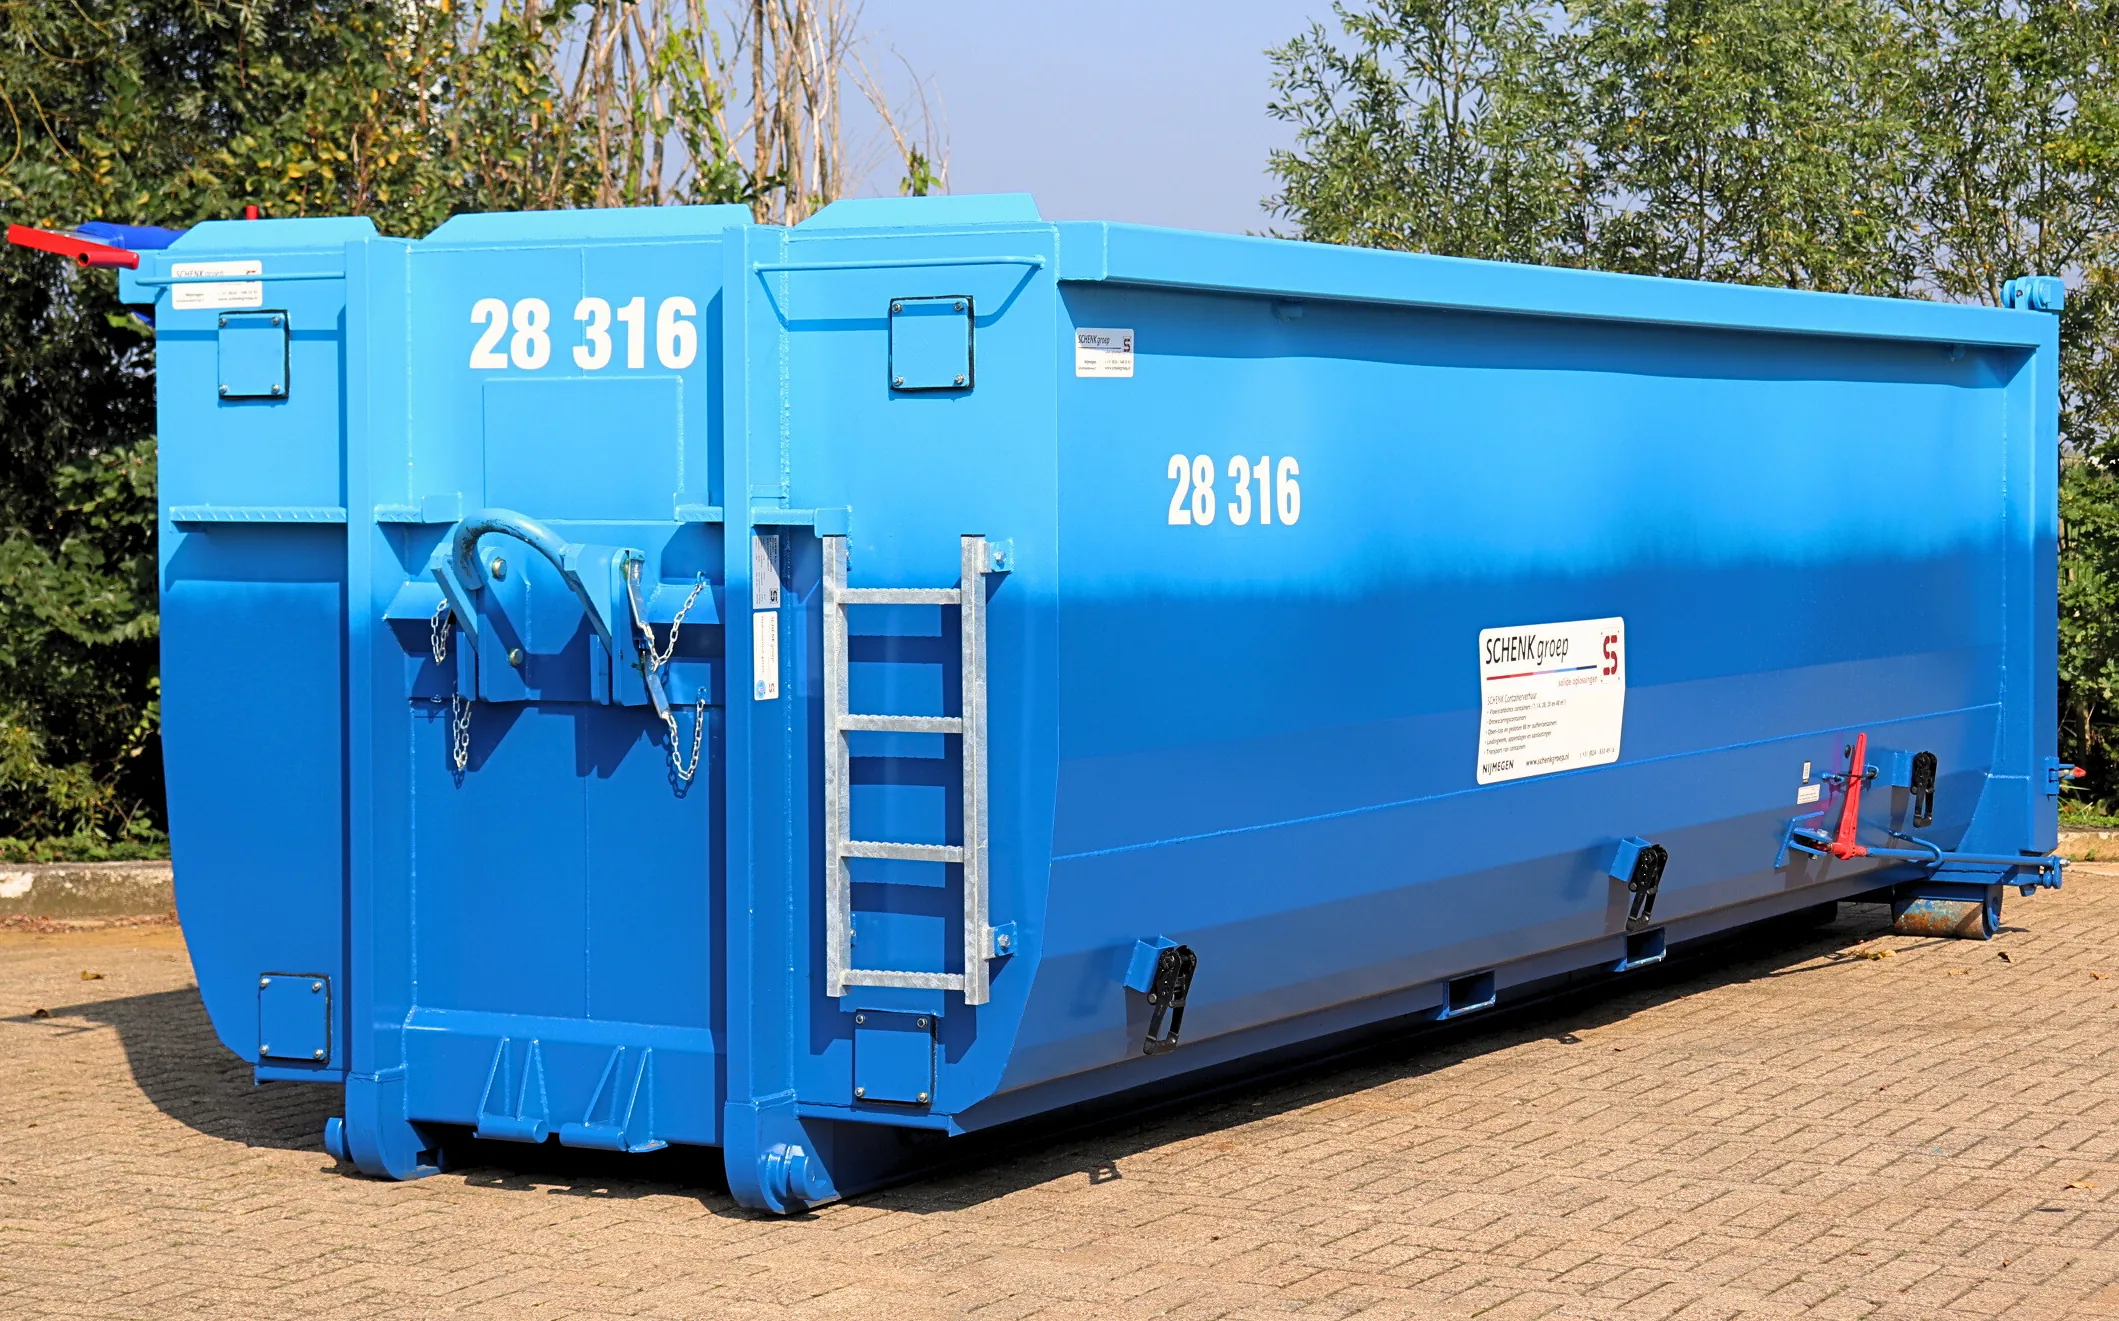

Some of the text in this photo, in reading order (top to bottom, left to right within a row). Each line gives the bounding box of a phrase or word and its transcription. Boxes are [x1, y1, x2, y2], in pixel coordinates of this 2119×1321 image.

[469, 296, 698, 370] 28 316
[1078, 334, 1111, 346] SCHENK groep
[1167, 453, 1301, 526] 28 316
[1485, 634, 1569, 666] SCHENK groep
[1482, 759, 1514, 776] NIJMEGEN
[1526, 752, 1570, 767] www.schenkgroep.nl
